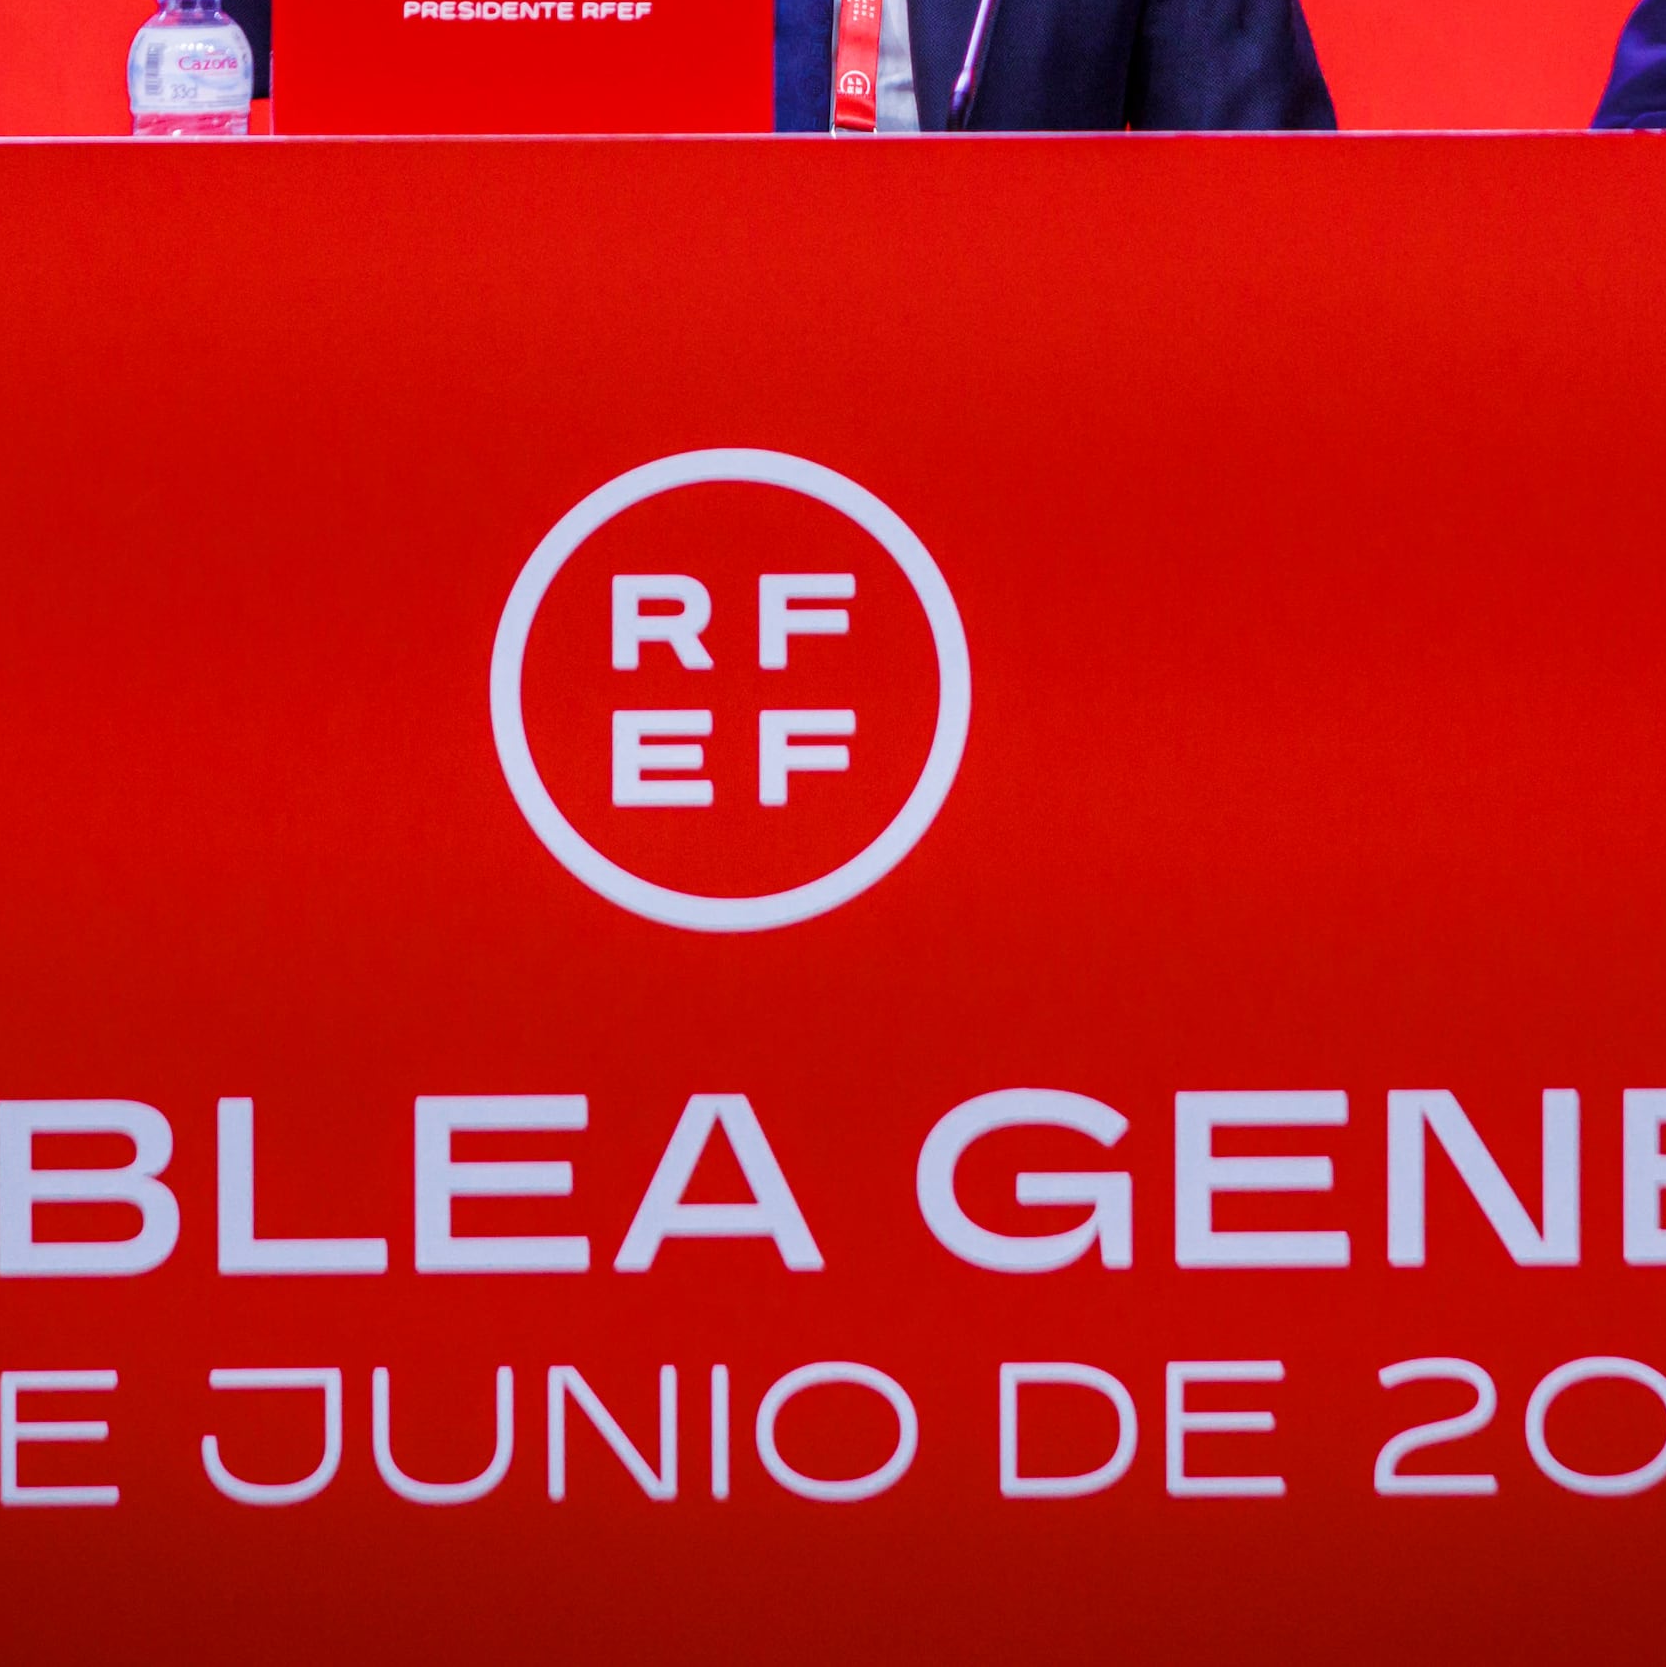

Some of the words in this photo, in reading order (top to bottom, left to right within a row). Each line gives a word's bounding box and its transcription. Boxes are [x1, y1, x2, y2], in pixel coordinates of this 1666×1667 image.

[403, 1, 574, 21] PRESIDENTE
[581, 1, 652, 21] RFEF
[612, 573, 857, 671] RF
[612, 709, 857, 808] EF
[199, 1360, 919, 1505] JUNIO
[998, 1359, 1287, 1499] DE
